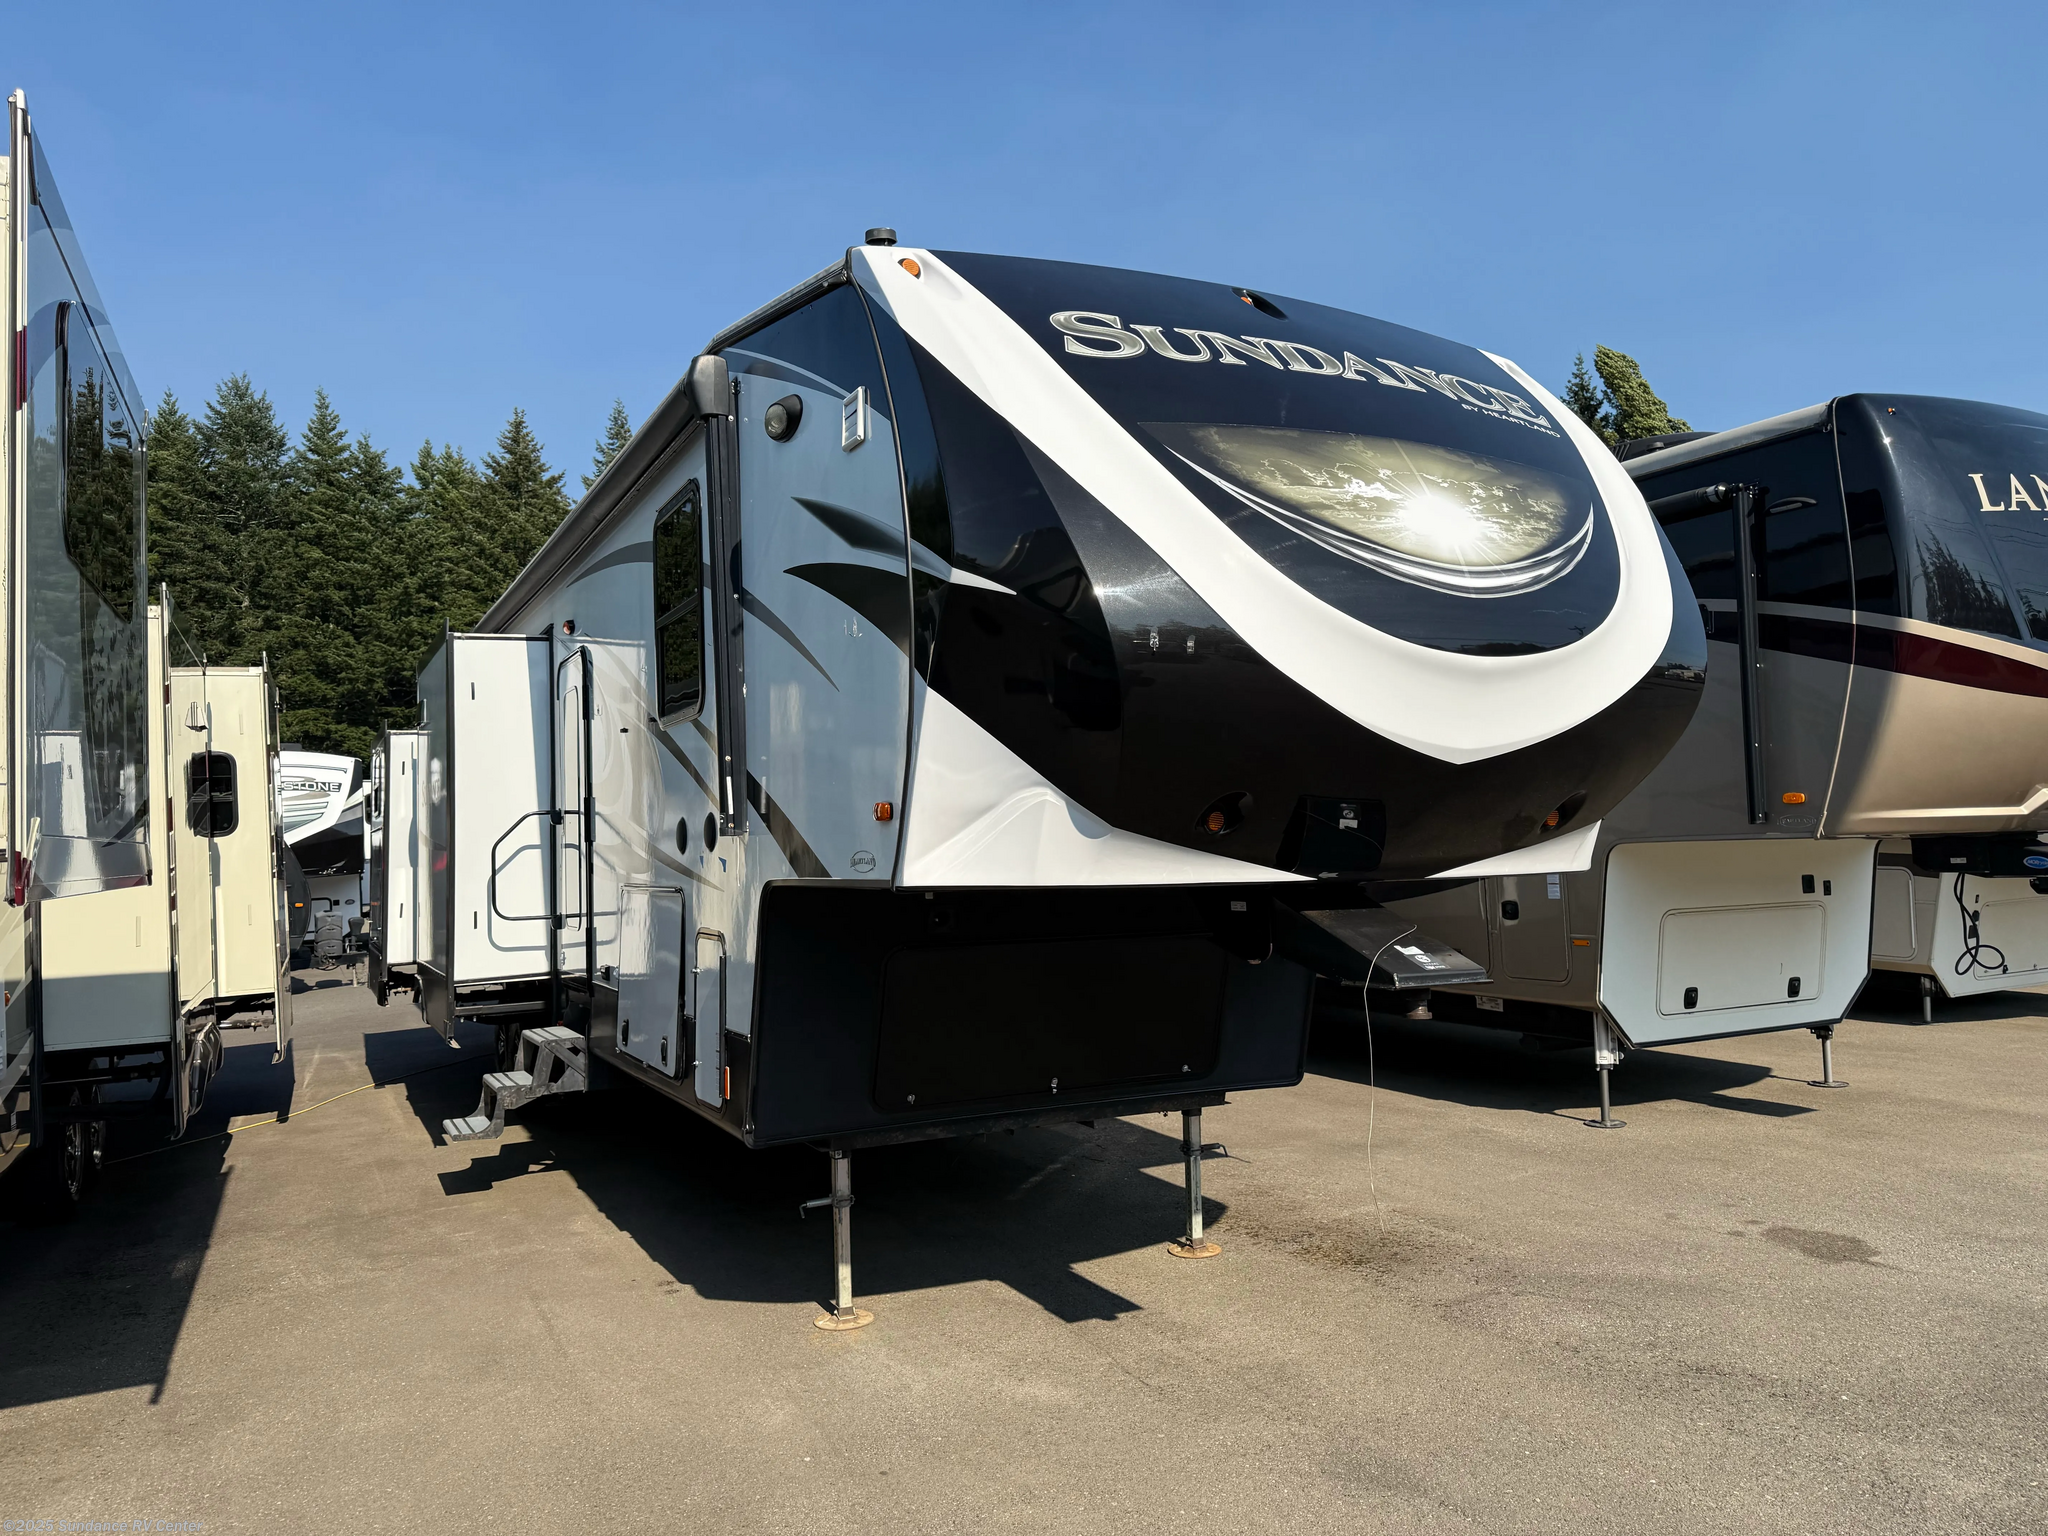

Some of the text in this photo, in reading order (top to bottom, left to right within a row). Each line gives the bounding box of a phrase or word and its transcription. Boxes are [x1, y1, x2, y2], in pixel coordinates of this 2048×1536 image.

[1049, 310, 1552, 429] SUNDANCE
[1461, 403, 1561, 438] BY HEARTLAND
[281, 781, 341, 792] STONE
